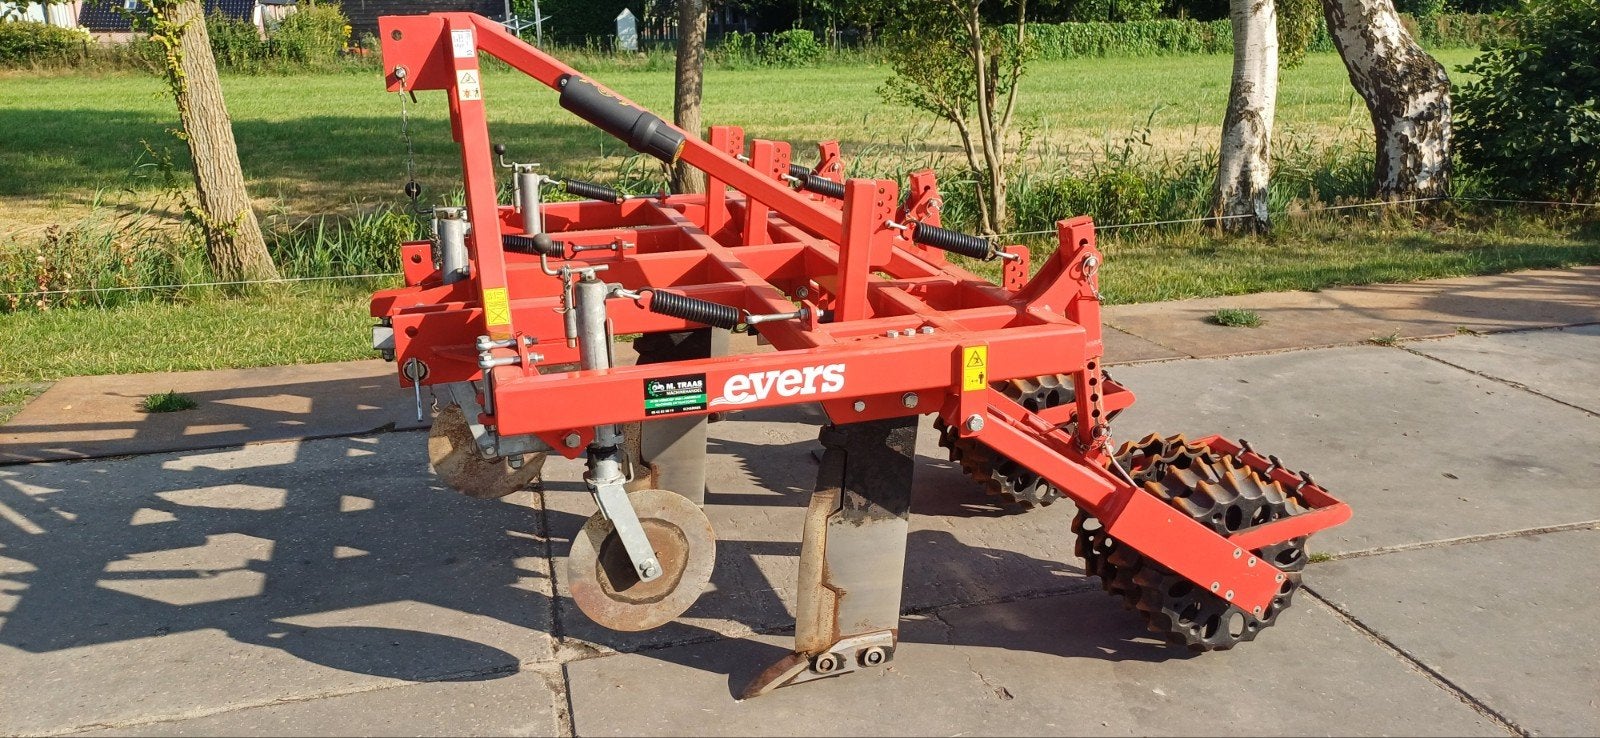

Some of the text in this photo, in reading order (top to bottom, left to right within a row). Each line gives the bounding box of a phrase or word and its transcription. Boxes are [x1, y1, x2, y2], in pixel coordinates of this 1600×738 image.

[666, 380, 703, 390] M. TRAAS
[720, 363, 846, 403] evers
